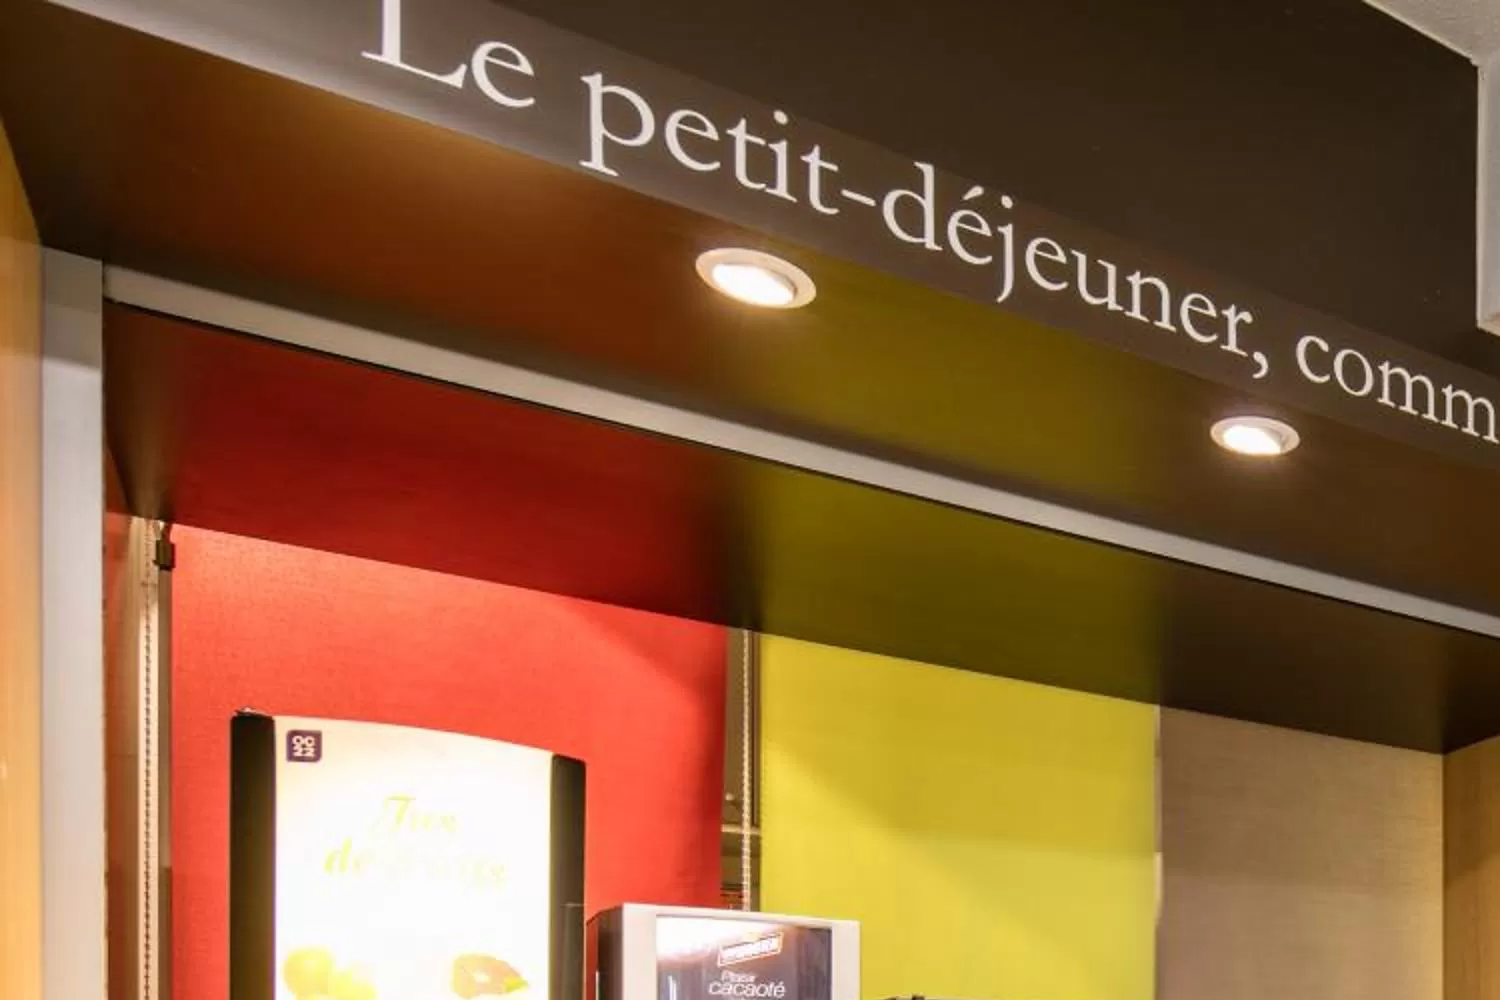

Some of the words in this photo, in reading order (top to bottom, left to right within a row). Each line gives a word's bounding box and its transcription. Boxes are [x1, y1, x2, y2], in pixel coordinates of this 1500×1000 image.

[361, 0, 535, 108] Le
[578, 72, 1270, 379] petit-déjeuner,
[707, 981, 786, 999] cacaoté
